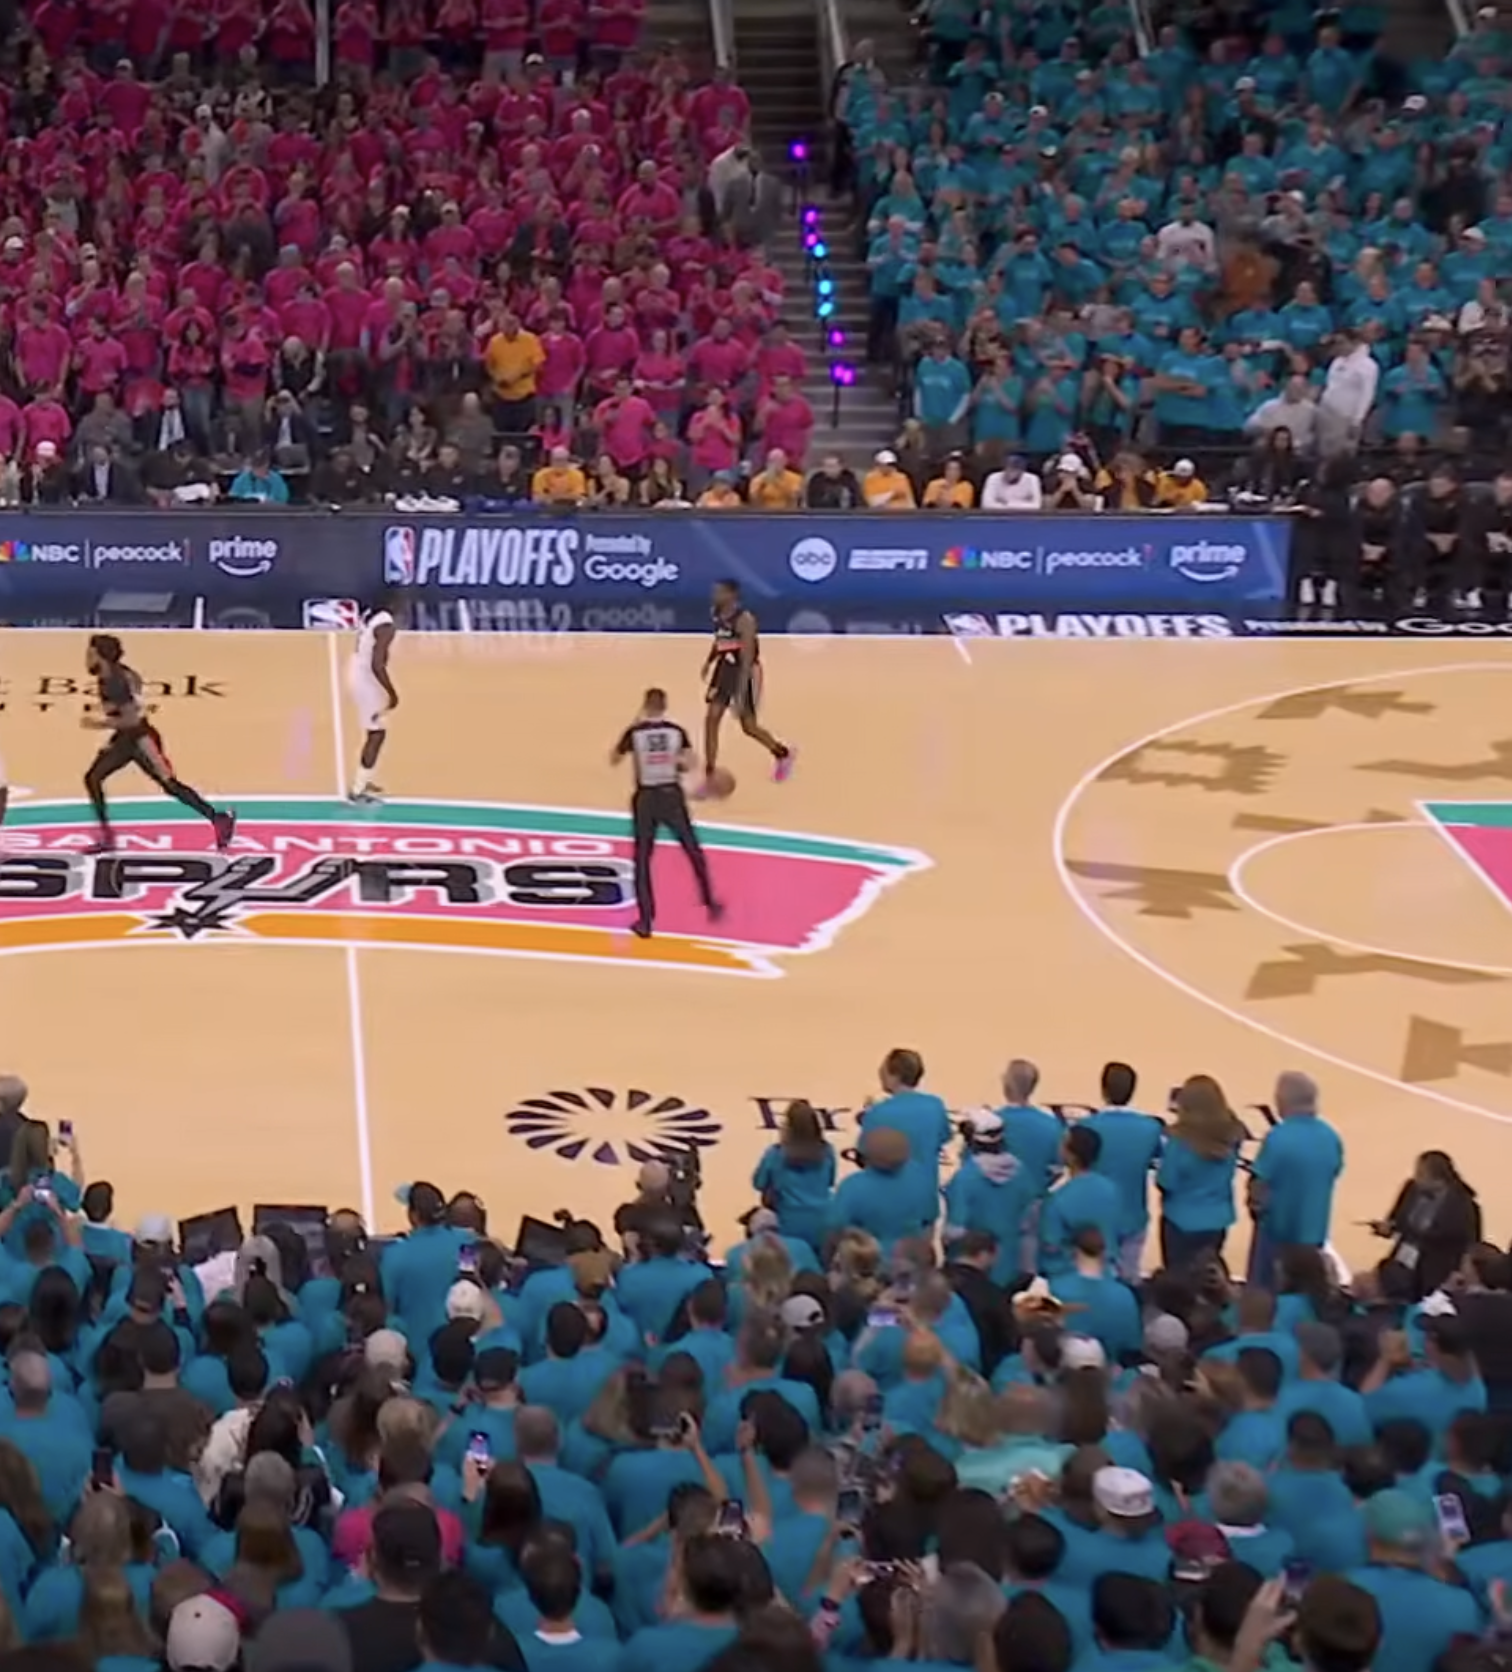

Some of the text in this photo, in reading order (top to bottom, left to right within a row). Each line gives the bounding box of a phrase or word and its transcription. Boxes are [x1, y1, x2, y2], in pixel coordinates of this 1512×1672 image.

[31, 541, 183, 568] NBC peacock
[208, 535, 278, 563] prime
[416, 528, 579, 585] PLAYOFFS
[794, 551, 832, 566] abc
[848, 550, 929, 570] ESPN
[981, 547, 1142, 575] NBC peacock
[1169, 540, 1246, 567] prime
[584, 555, 679, 587] Google
[996, 614, 1235, 637] PLAYOFFS
[207, 834, 614, 856] ANTONIO
